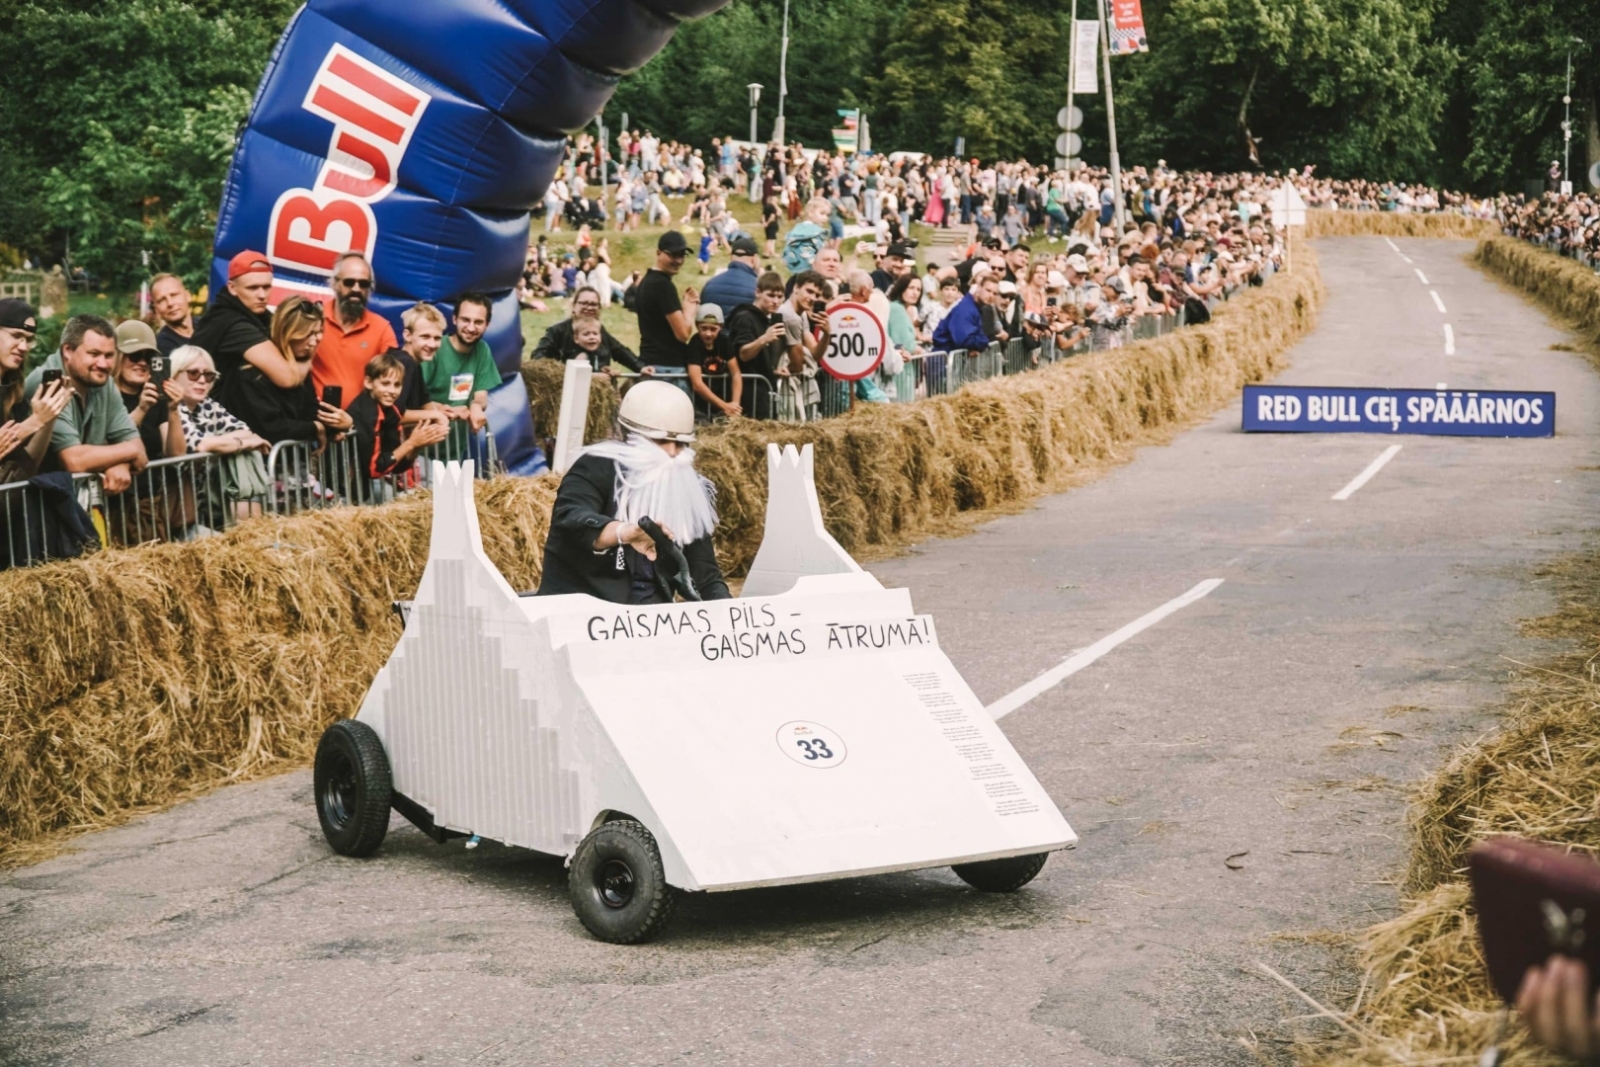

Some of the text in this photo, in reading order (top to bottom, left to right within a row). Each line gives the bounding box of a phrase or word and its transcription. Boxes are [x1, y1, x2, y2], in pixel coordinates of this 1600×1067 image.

[270, 46, 428, 277] Bull
[828, 332, 878, 358] 500 m
[1258, 392, 1544, 431] RED BULL CEĻ SPĀĀĀRNOS
[825, 617, 931, 650] ĀTRUMĀ!
[796, 738, 834, 761] 33
